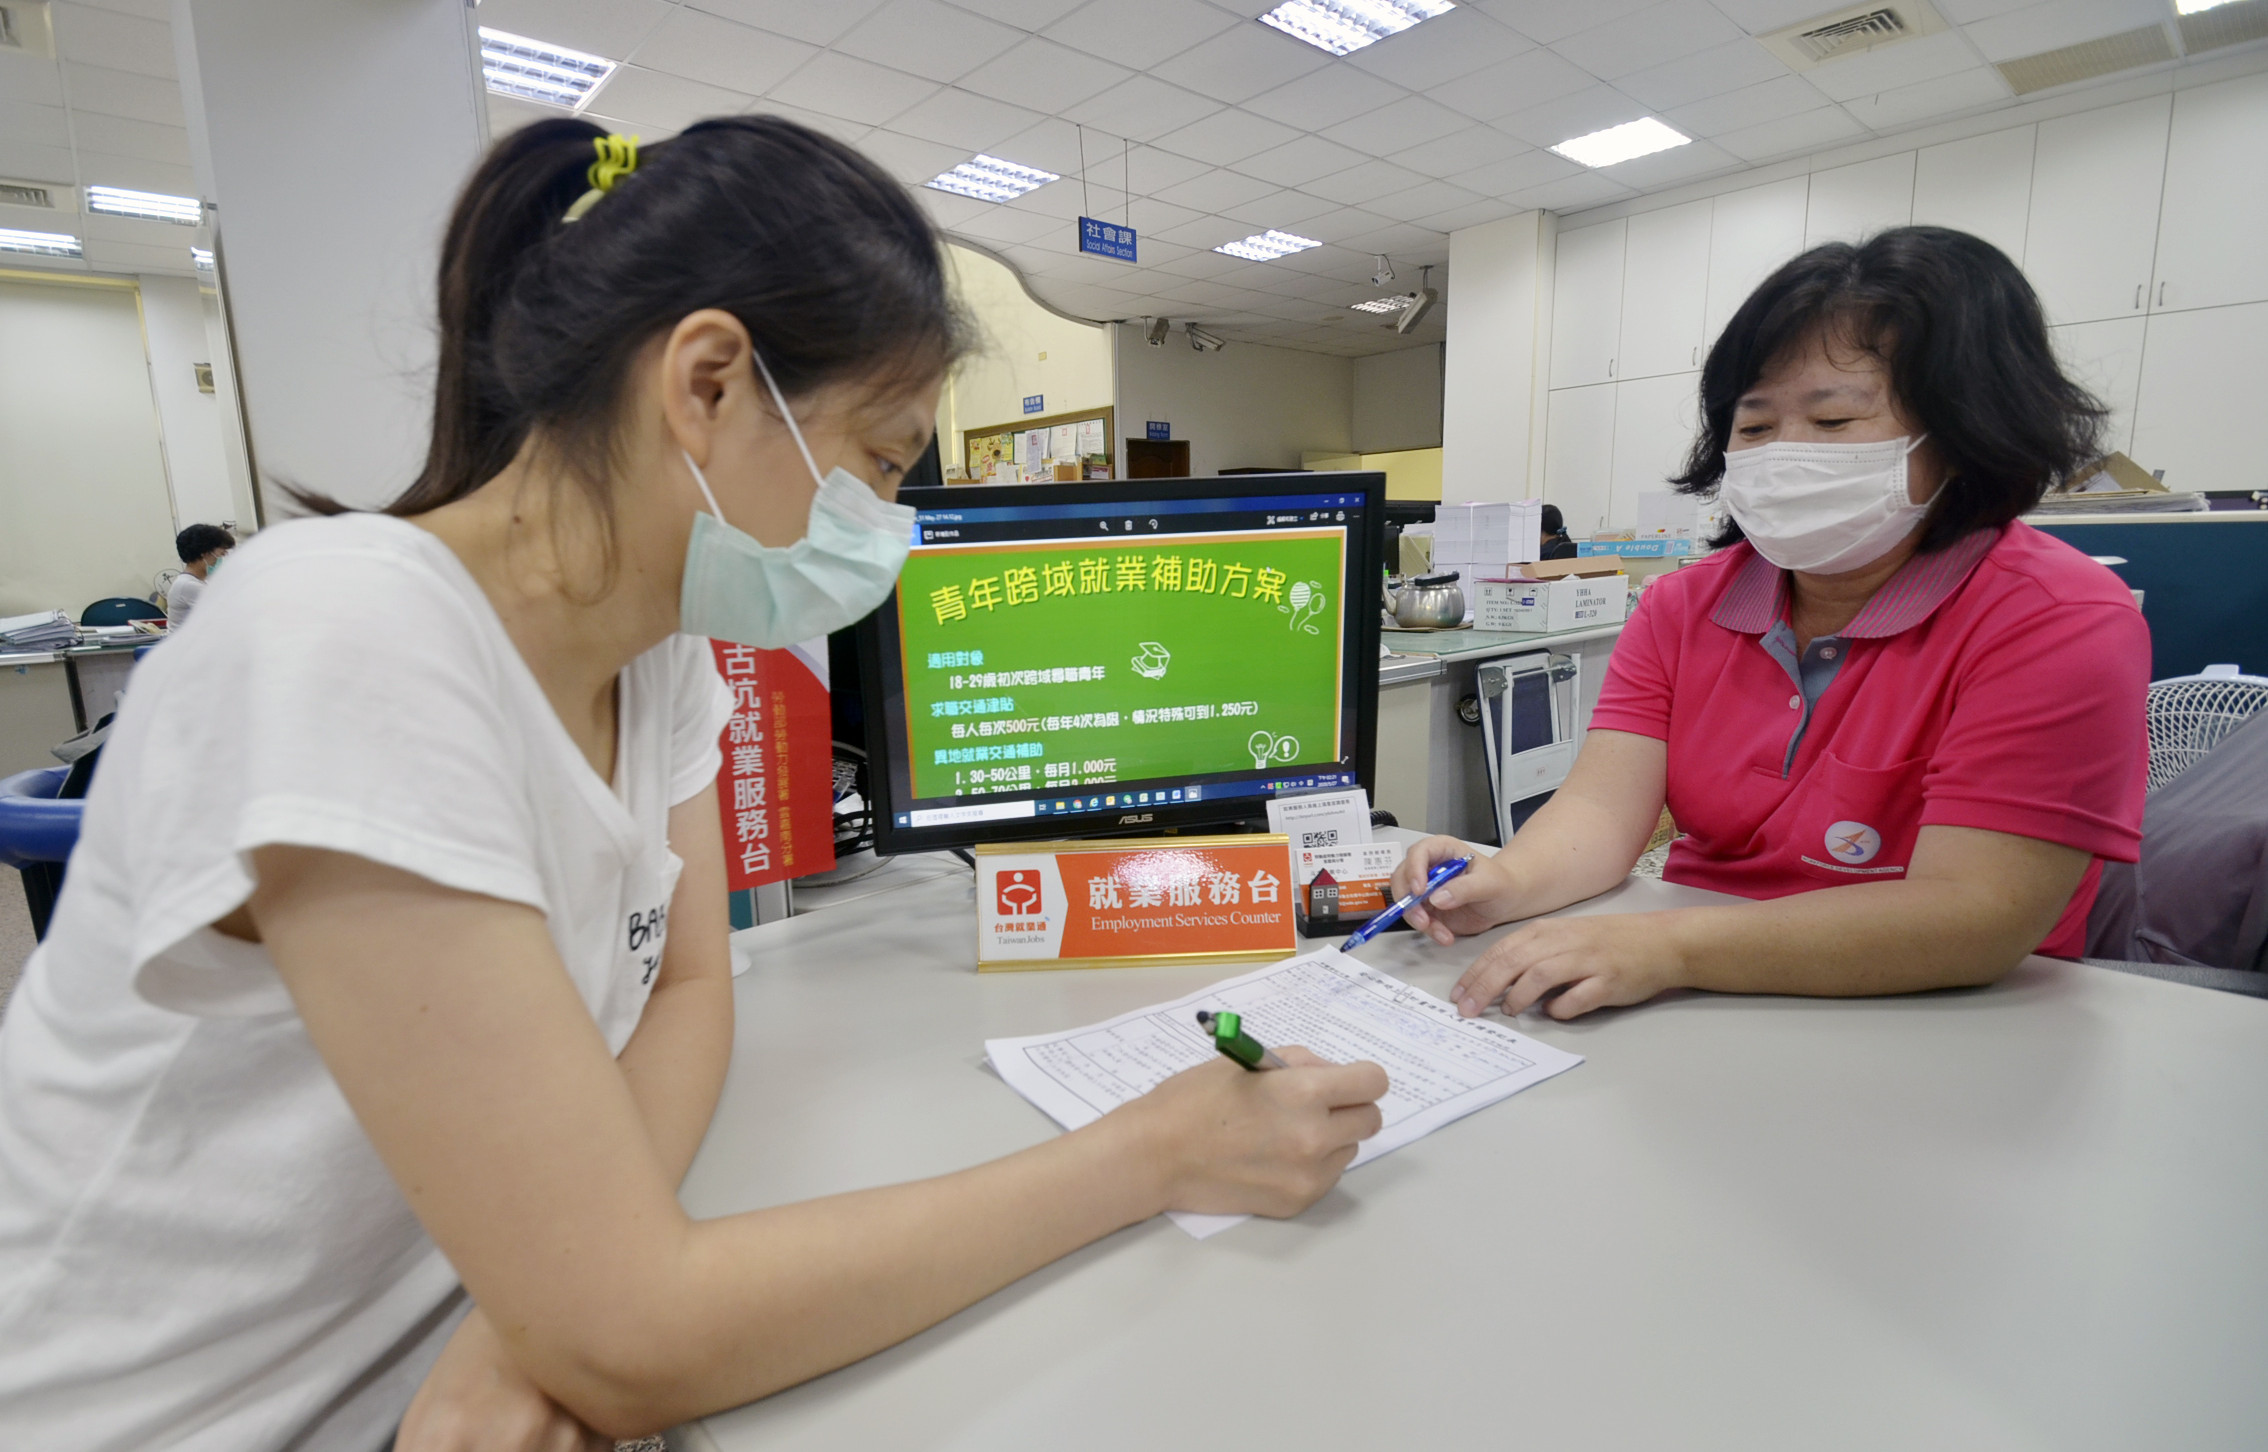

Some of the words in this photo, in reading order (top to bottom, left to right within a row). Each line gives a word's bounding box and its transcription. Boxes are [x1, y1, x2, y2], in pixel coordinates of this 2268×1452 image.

[1086, 222, 1132, 245] 社會課
[1086, 239, 1100, 251] Social
[1116, 246, 1132, 258] Section
[1616, 544, 1622, 552] A
[1625, 544, 1659, 552] Double
[929, 555, 1287, 625] 青年跨域就業補助方案
[1575, 597, 1606, 608] LAMINATOR
[930, 697, 1015, 717] 求職交通津貼
[722, 644, 771, 875] 古坑就業服務台
[934, 742, 1043, 765] 異地就業交通補助
[1118, 813, 1153, 824] ASUS
[1088, 869, 1281, 911] 就業服務台
[994, 921, 1047, 933] 台灣就業通
[1091, 916, 1174, 933] Employment
[1175, 914, 1228, 928] Services
[1230, 910, 1281, 926] Counter
